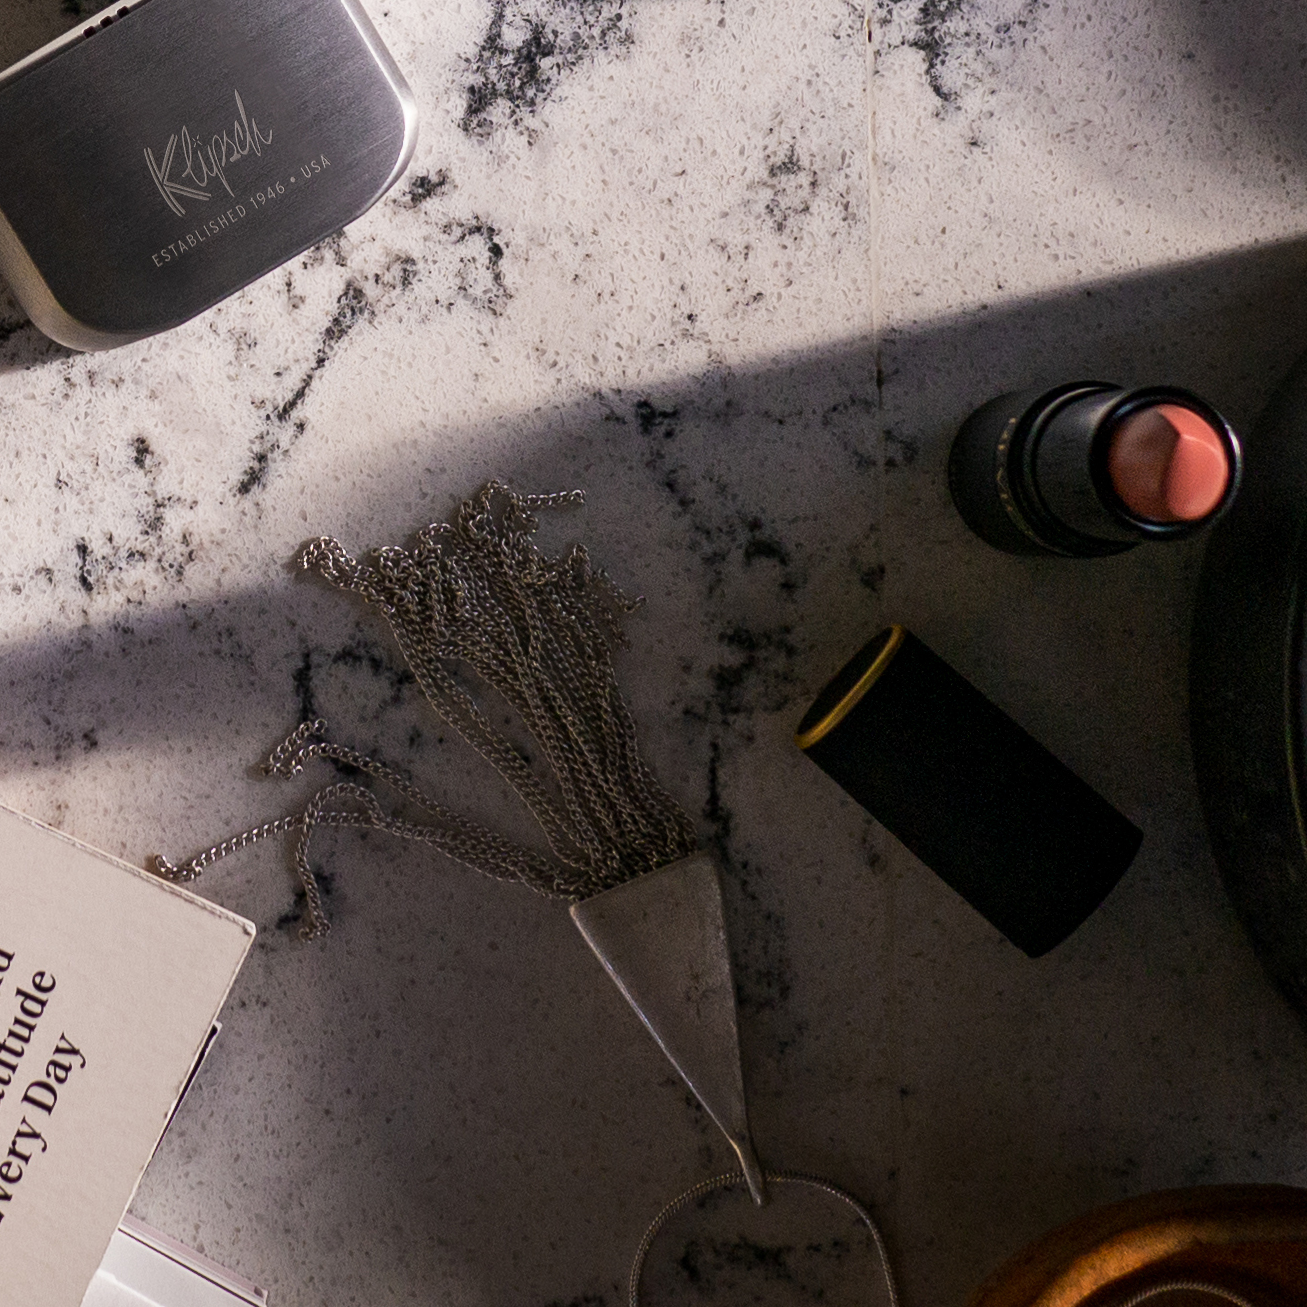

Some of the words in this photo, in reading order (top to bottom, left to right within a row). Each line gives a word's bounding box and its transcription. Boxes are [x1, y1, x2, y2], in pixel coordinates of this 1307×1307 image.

[143, 88, 274, 217] Klipsch
[151, 204, 247, 268] ESTABLISHED
[249, 181, 286, 210] 1946
[300, 154, 332, 179] USA
[21, 1031, 87, 1116] Day
